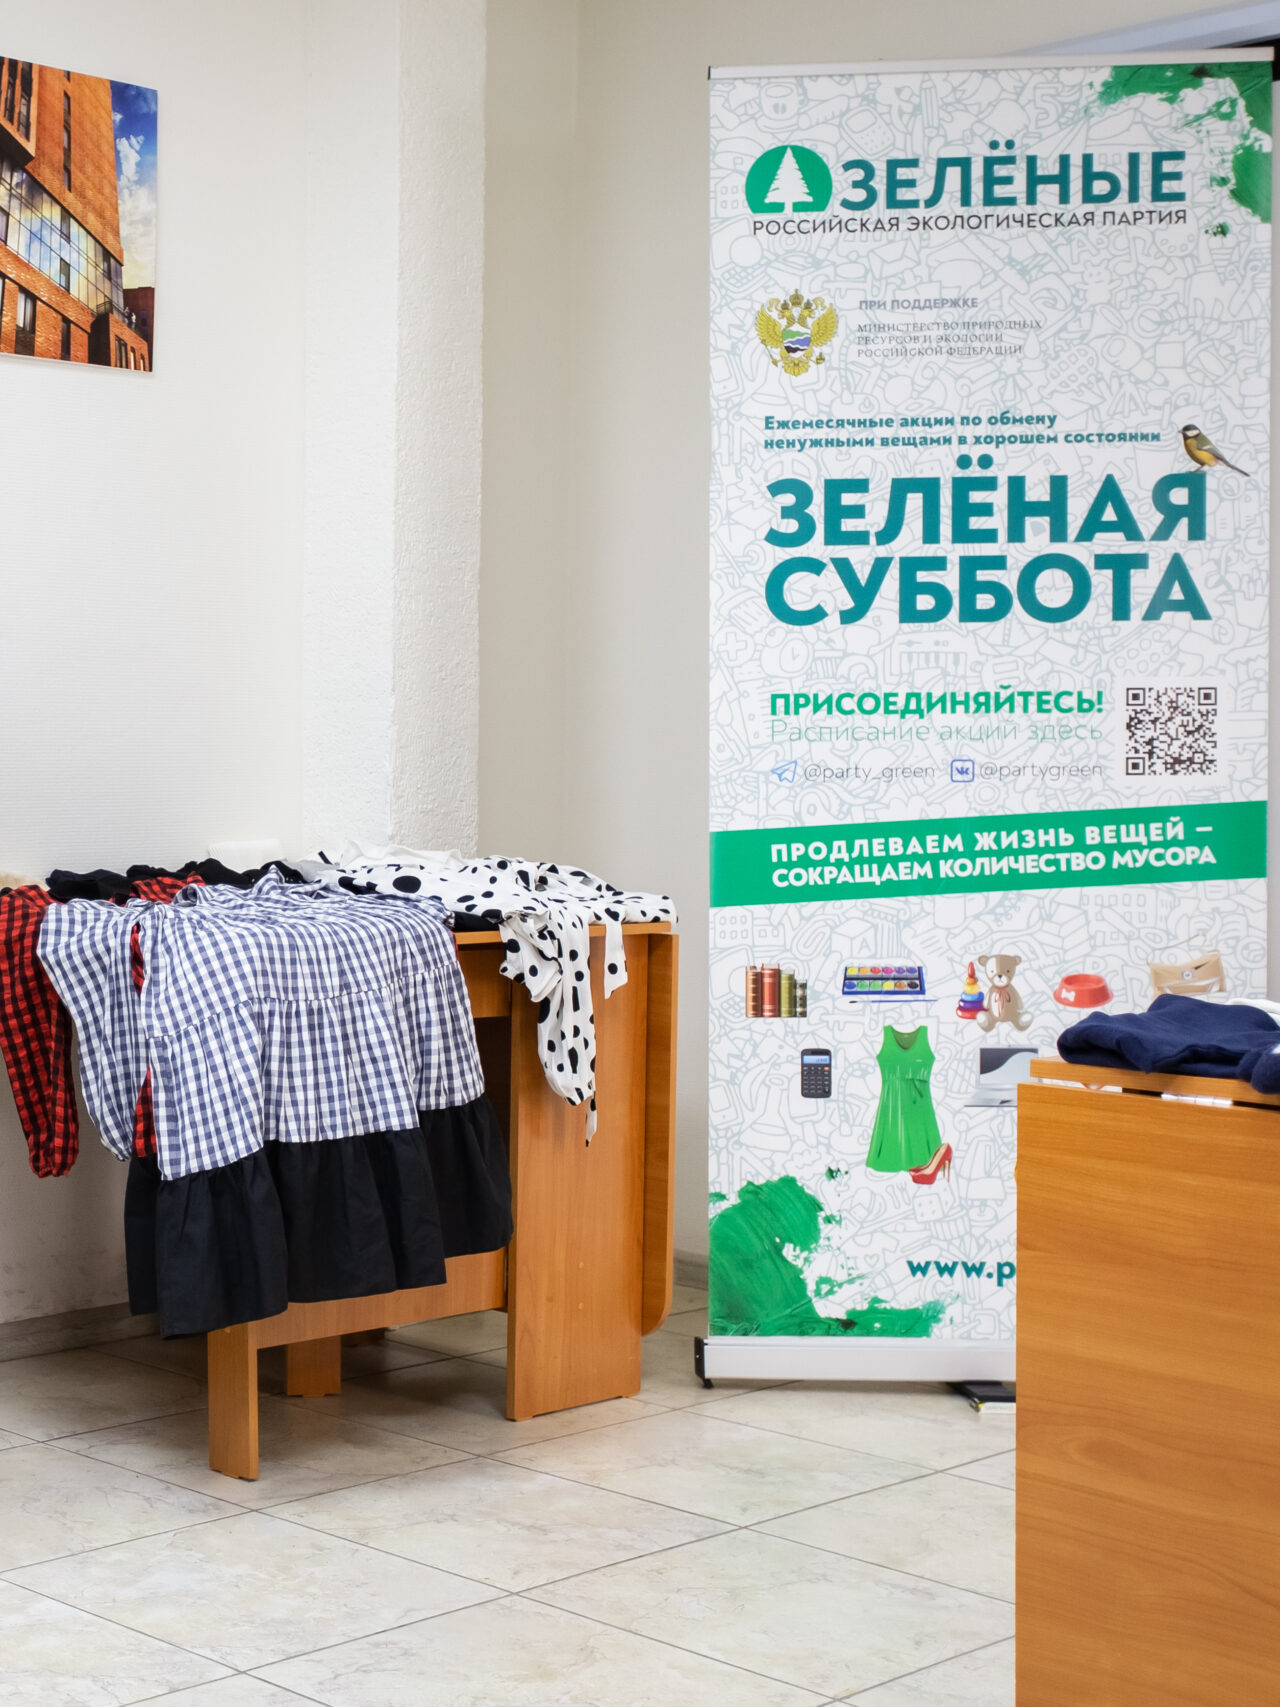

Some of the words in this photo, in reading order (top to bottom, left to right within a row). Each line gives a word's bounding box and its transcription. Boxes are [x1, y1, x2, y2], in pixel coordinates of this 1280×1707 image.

[839, 139, 1187, 211] ЗЕЛЁНЫЕ
[753, 214, 900, 236] РОССИЙСКАЯ
[906, 211, 1096, 231] ЭКОЛОГИЧЕСКАЯ
[1102, 209, 1187, 226] ПАРТИЯ
[859, 299, 887, 311] ПРИ
[891, 297, 979, 311] ПОДДЕРЖКЕ
[857, 321, 959, 333] МИНИСТЕРСТВО
[962, 319, 1042, 332] ПРИРОДНЫХ
[857, 335, 920, 346] РЕСУРСОВ
[923, 334, 932, 344] И
[935, 332, 1003, 344] ЭКОЛОГИИ
[857, 346, 943, 358] РОССИЙСКОЙ
[946, 344, 1022, 356] ФЕДЕРАЦИИ
[764, 415, 895, 431] Ежемесячные
[899, 416, 955, 429] акции
[960, 415, 982, 426] по
[987, 410, 1058, 429] обмену
[764, 436, 875, 453] ненужными
[880, 435, 953, 448] вещами
[957, 435, 967, 445] в
[973, 434, 1059, 449] хорошем
[1063, 432, 1162, 444] состоянии
[764, 453, 1207, 548] ЗЕЛЁНАЯ
[765, 552, 1212, 626] СУББОТА
[770, 684, 1104, 719] ПРИСОЕДИНЯЙТЕСЬ!
[770, 719, 931, 742] Расписание
[939, 720, 1018, 742] акций
[1027, 723, 1104, 742] здесь
[804, 762, 936, 780] @party_green
[979, 761, 1103, 780] @partygreen
[771, 834, 965, 863] ПРОДЛЕВАЕМ
[974, 826, 1074, 851] ЖИЗНЬ
[1085, 815, 1185, 844] ВЕЩЕЙ
[772, 863, 933, 888] СОКРАЩАЕМ
[939, 851, 1106, 880] КОЛИЧЕСТВО
[1112, 845, 1217, 870] МУСОРА
